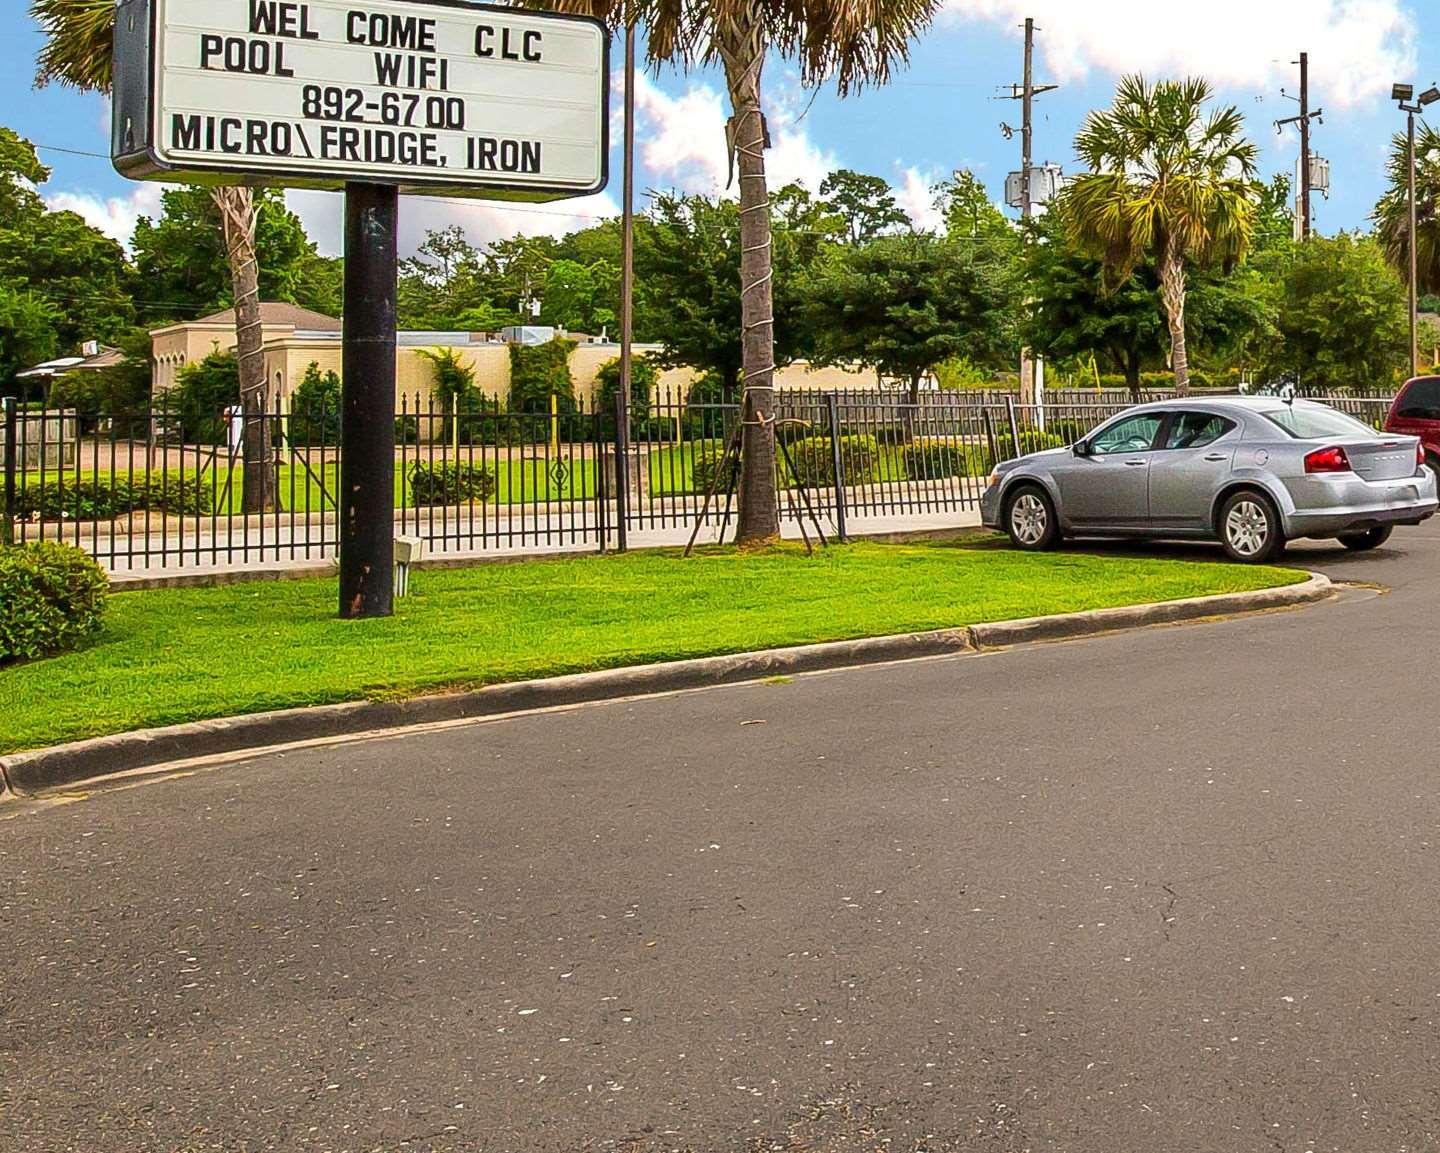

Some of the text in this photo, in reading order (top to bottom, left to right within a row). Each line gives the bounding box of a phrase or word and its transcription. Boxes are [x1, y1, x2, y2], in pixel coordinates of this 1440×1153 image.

[201, 34, 447, 90] POOL WIFI
[475, 24, 542, 62] CLC
[302, 84, 465, 130] 892-6700
[467, 137, 541, 174] IRON
